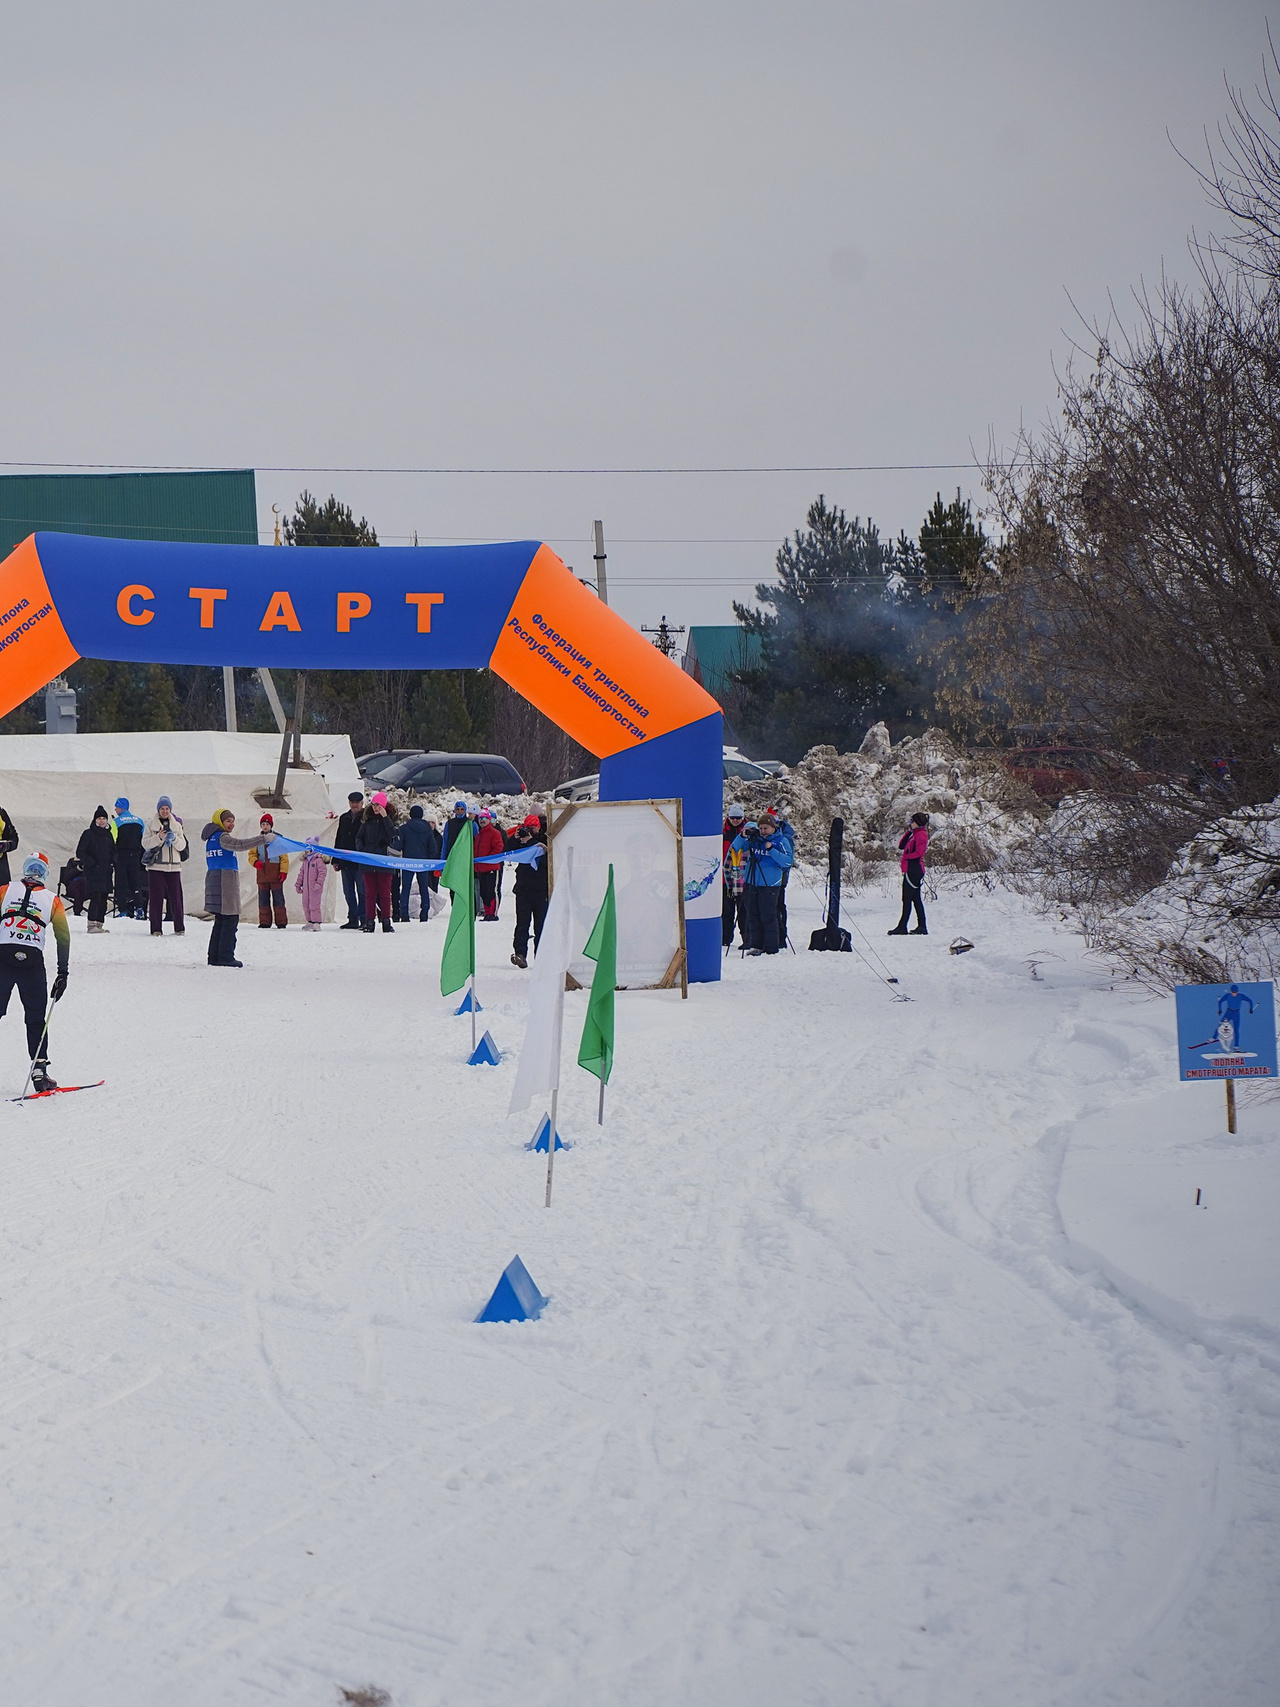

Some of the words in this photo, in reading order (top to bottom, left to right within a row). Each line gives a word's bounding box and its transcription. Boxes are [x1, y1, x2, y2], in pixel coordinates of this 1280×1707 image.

[116, 583, 445, 634] СТАРТ
[507, 617, 572, 678] Республики
[571, 673, 647, 740] Башкортостан
[531, 613, 593, 670] Федерация
[592, 667, 650, 719] триатлона
[9, 930, 32, 941] УФА
[1186, 1068, 1237, 1078] СМОТРЯЩЕГО
